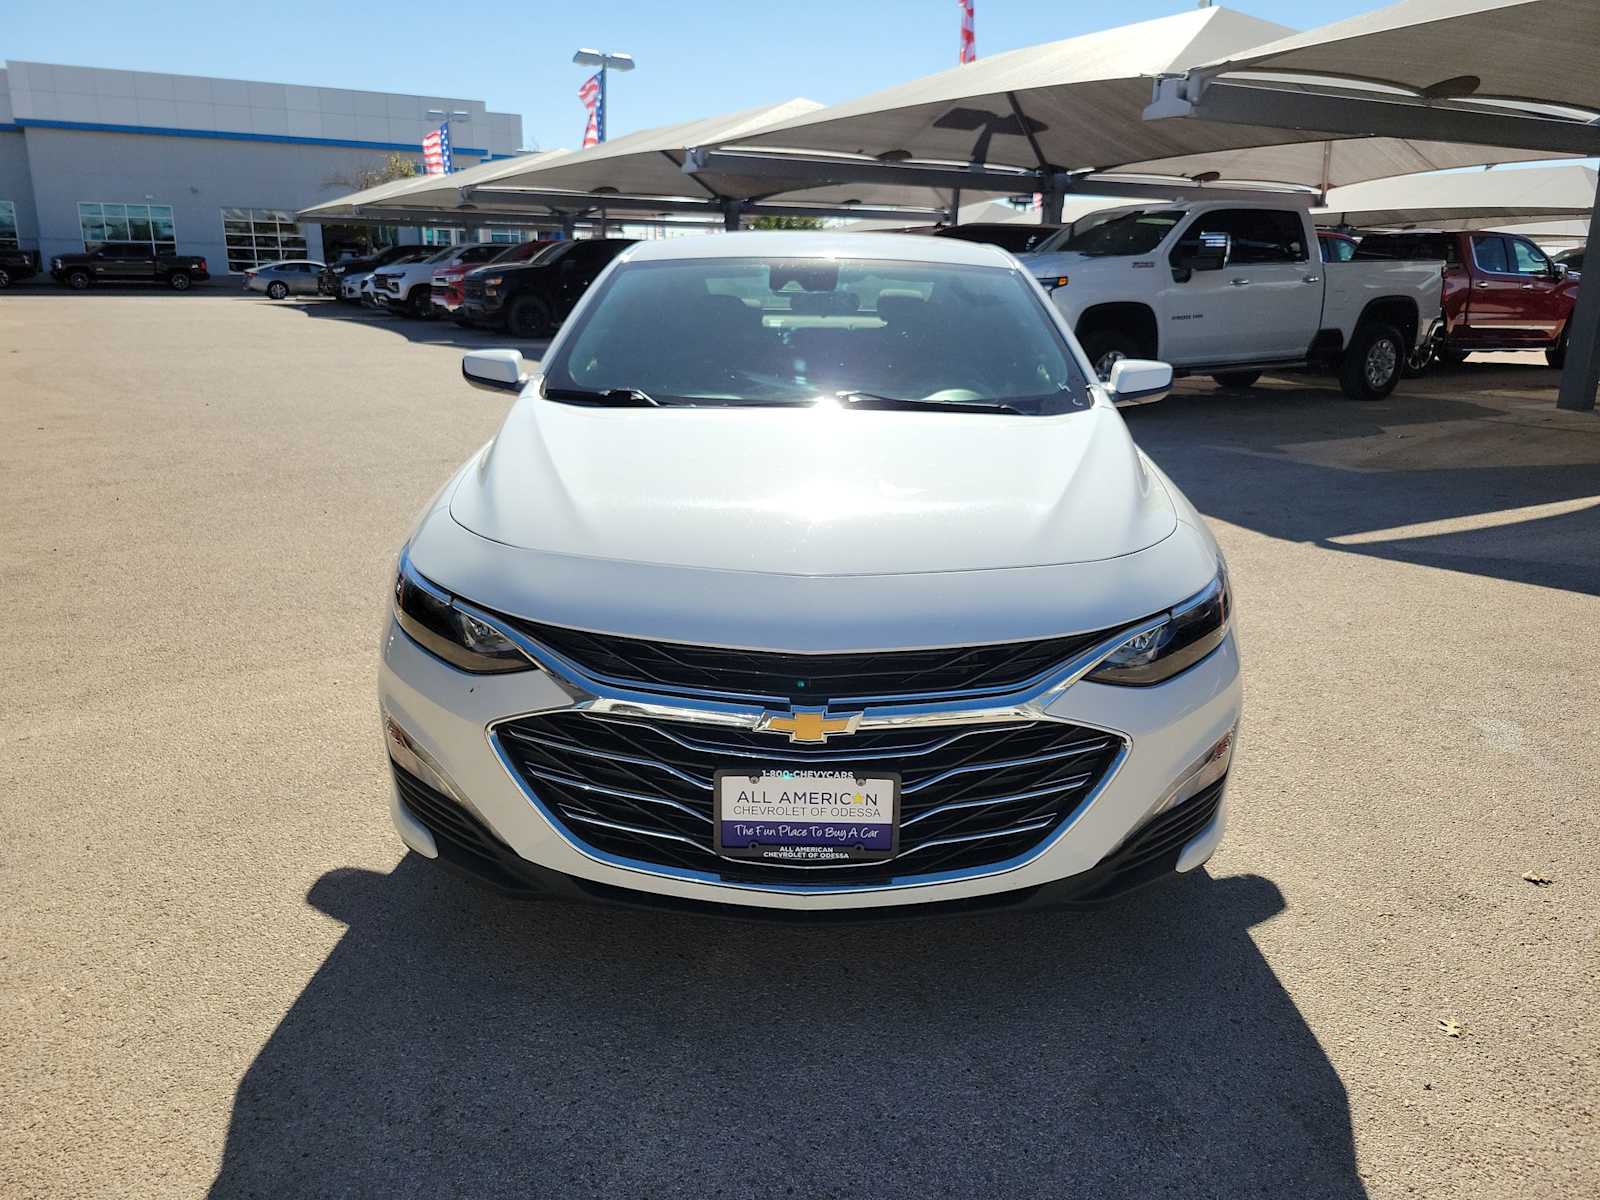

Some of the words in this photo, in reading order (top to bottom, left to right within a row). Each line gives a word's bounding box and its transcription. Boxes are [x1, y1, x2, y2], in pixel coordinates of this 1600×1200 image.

[737, 790, 772, 804] ALL
[733, 805, 807, 817] CHEVROLET
[810, 807, 827, 817] OF
[831, 807, 881, 818] ODESSA
[734, 824, 754, 837] The
[755, 825, 776, 837] Fun
[778, 824, 808, 837] Place
[809, 825, 823, 838] To
[825, 826, 847, 841] Buy
[847, 827, 858, 838] A
[860, 827, 880, 839] Car
